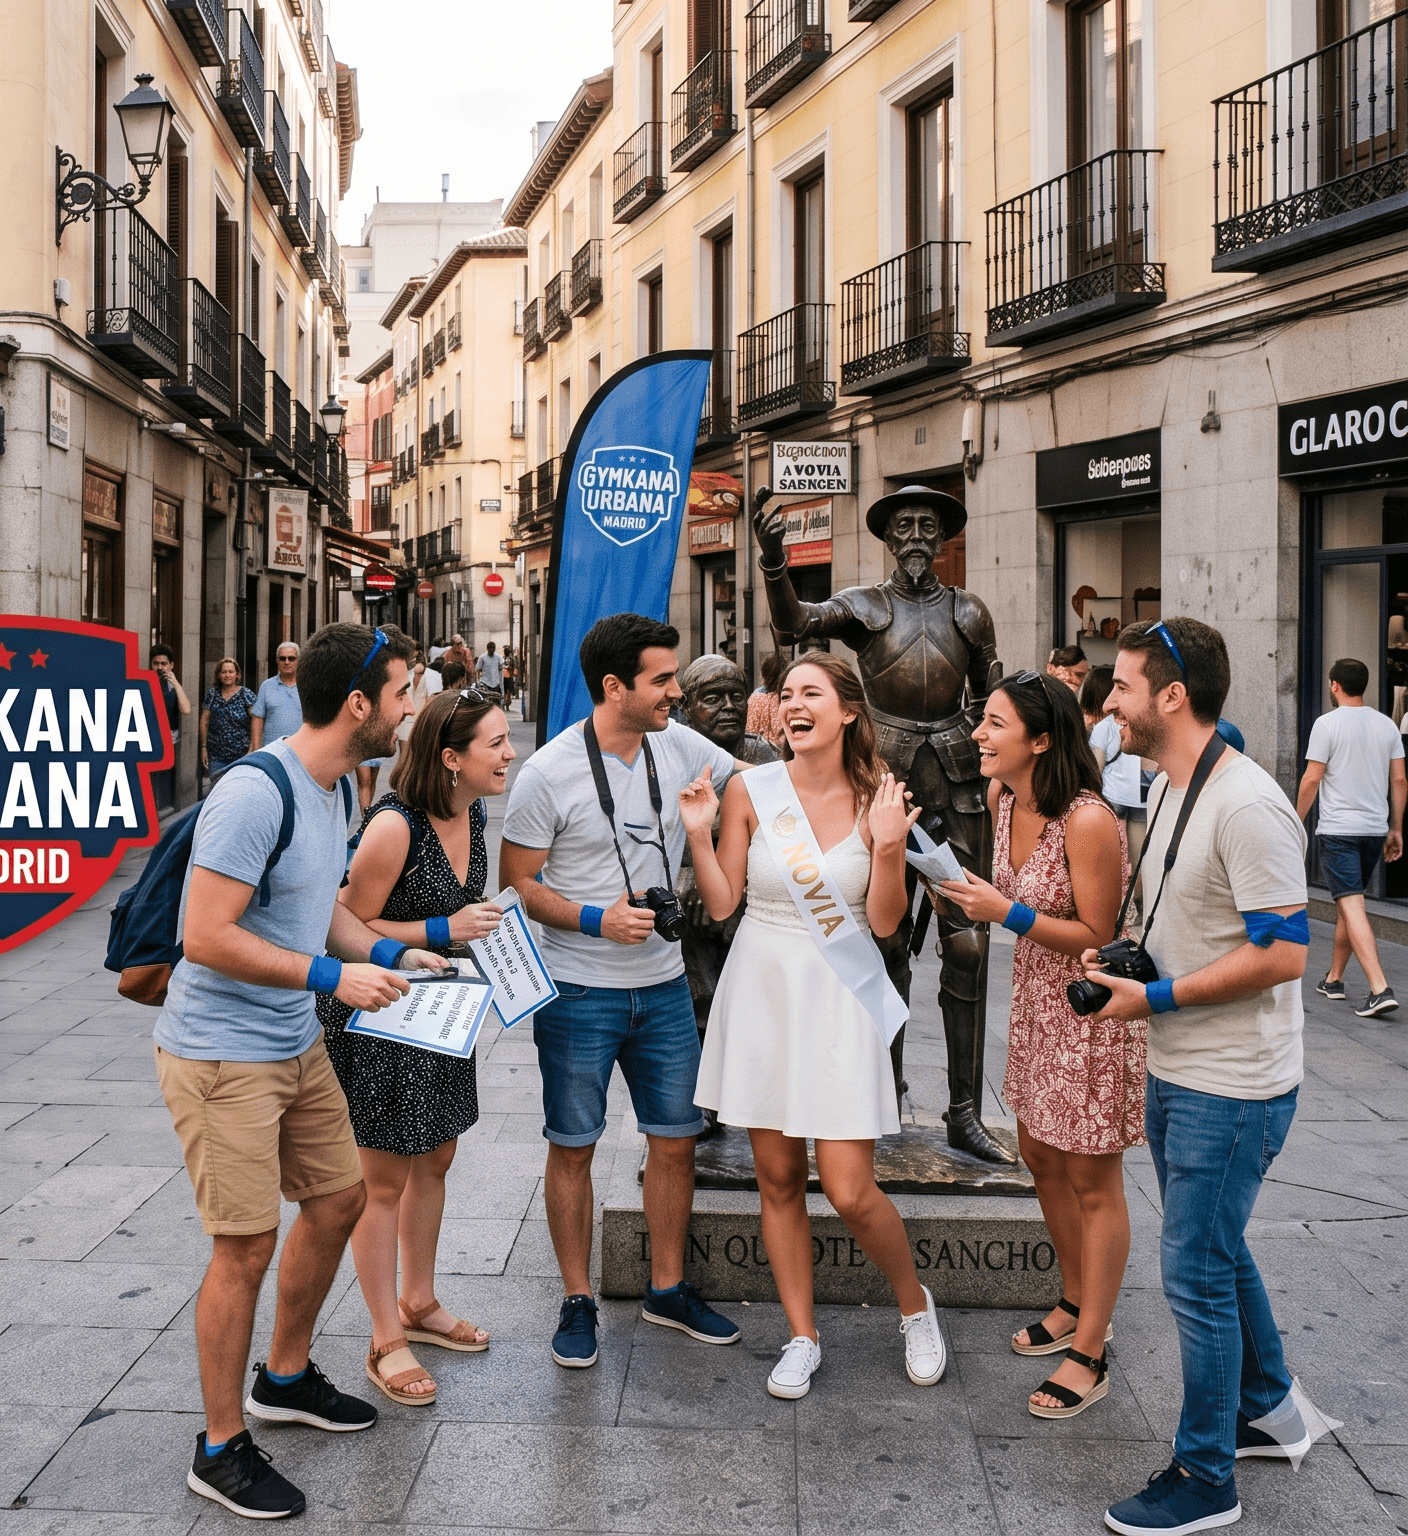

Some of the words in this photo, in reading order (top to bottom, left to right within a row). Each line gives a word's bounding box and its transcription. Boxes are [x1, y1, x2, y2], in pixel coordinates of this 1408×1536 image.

[583, 465, 674, 493] GYMKANA
[587, 489, 665, 515] URBANA
[781, 842, 846, 938] NOVIA
[915, 1238, 1056, 1272] SANCHO
